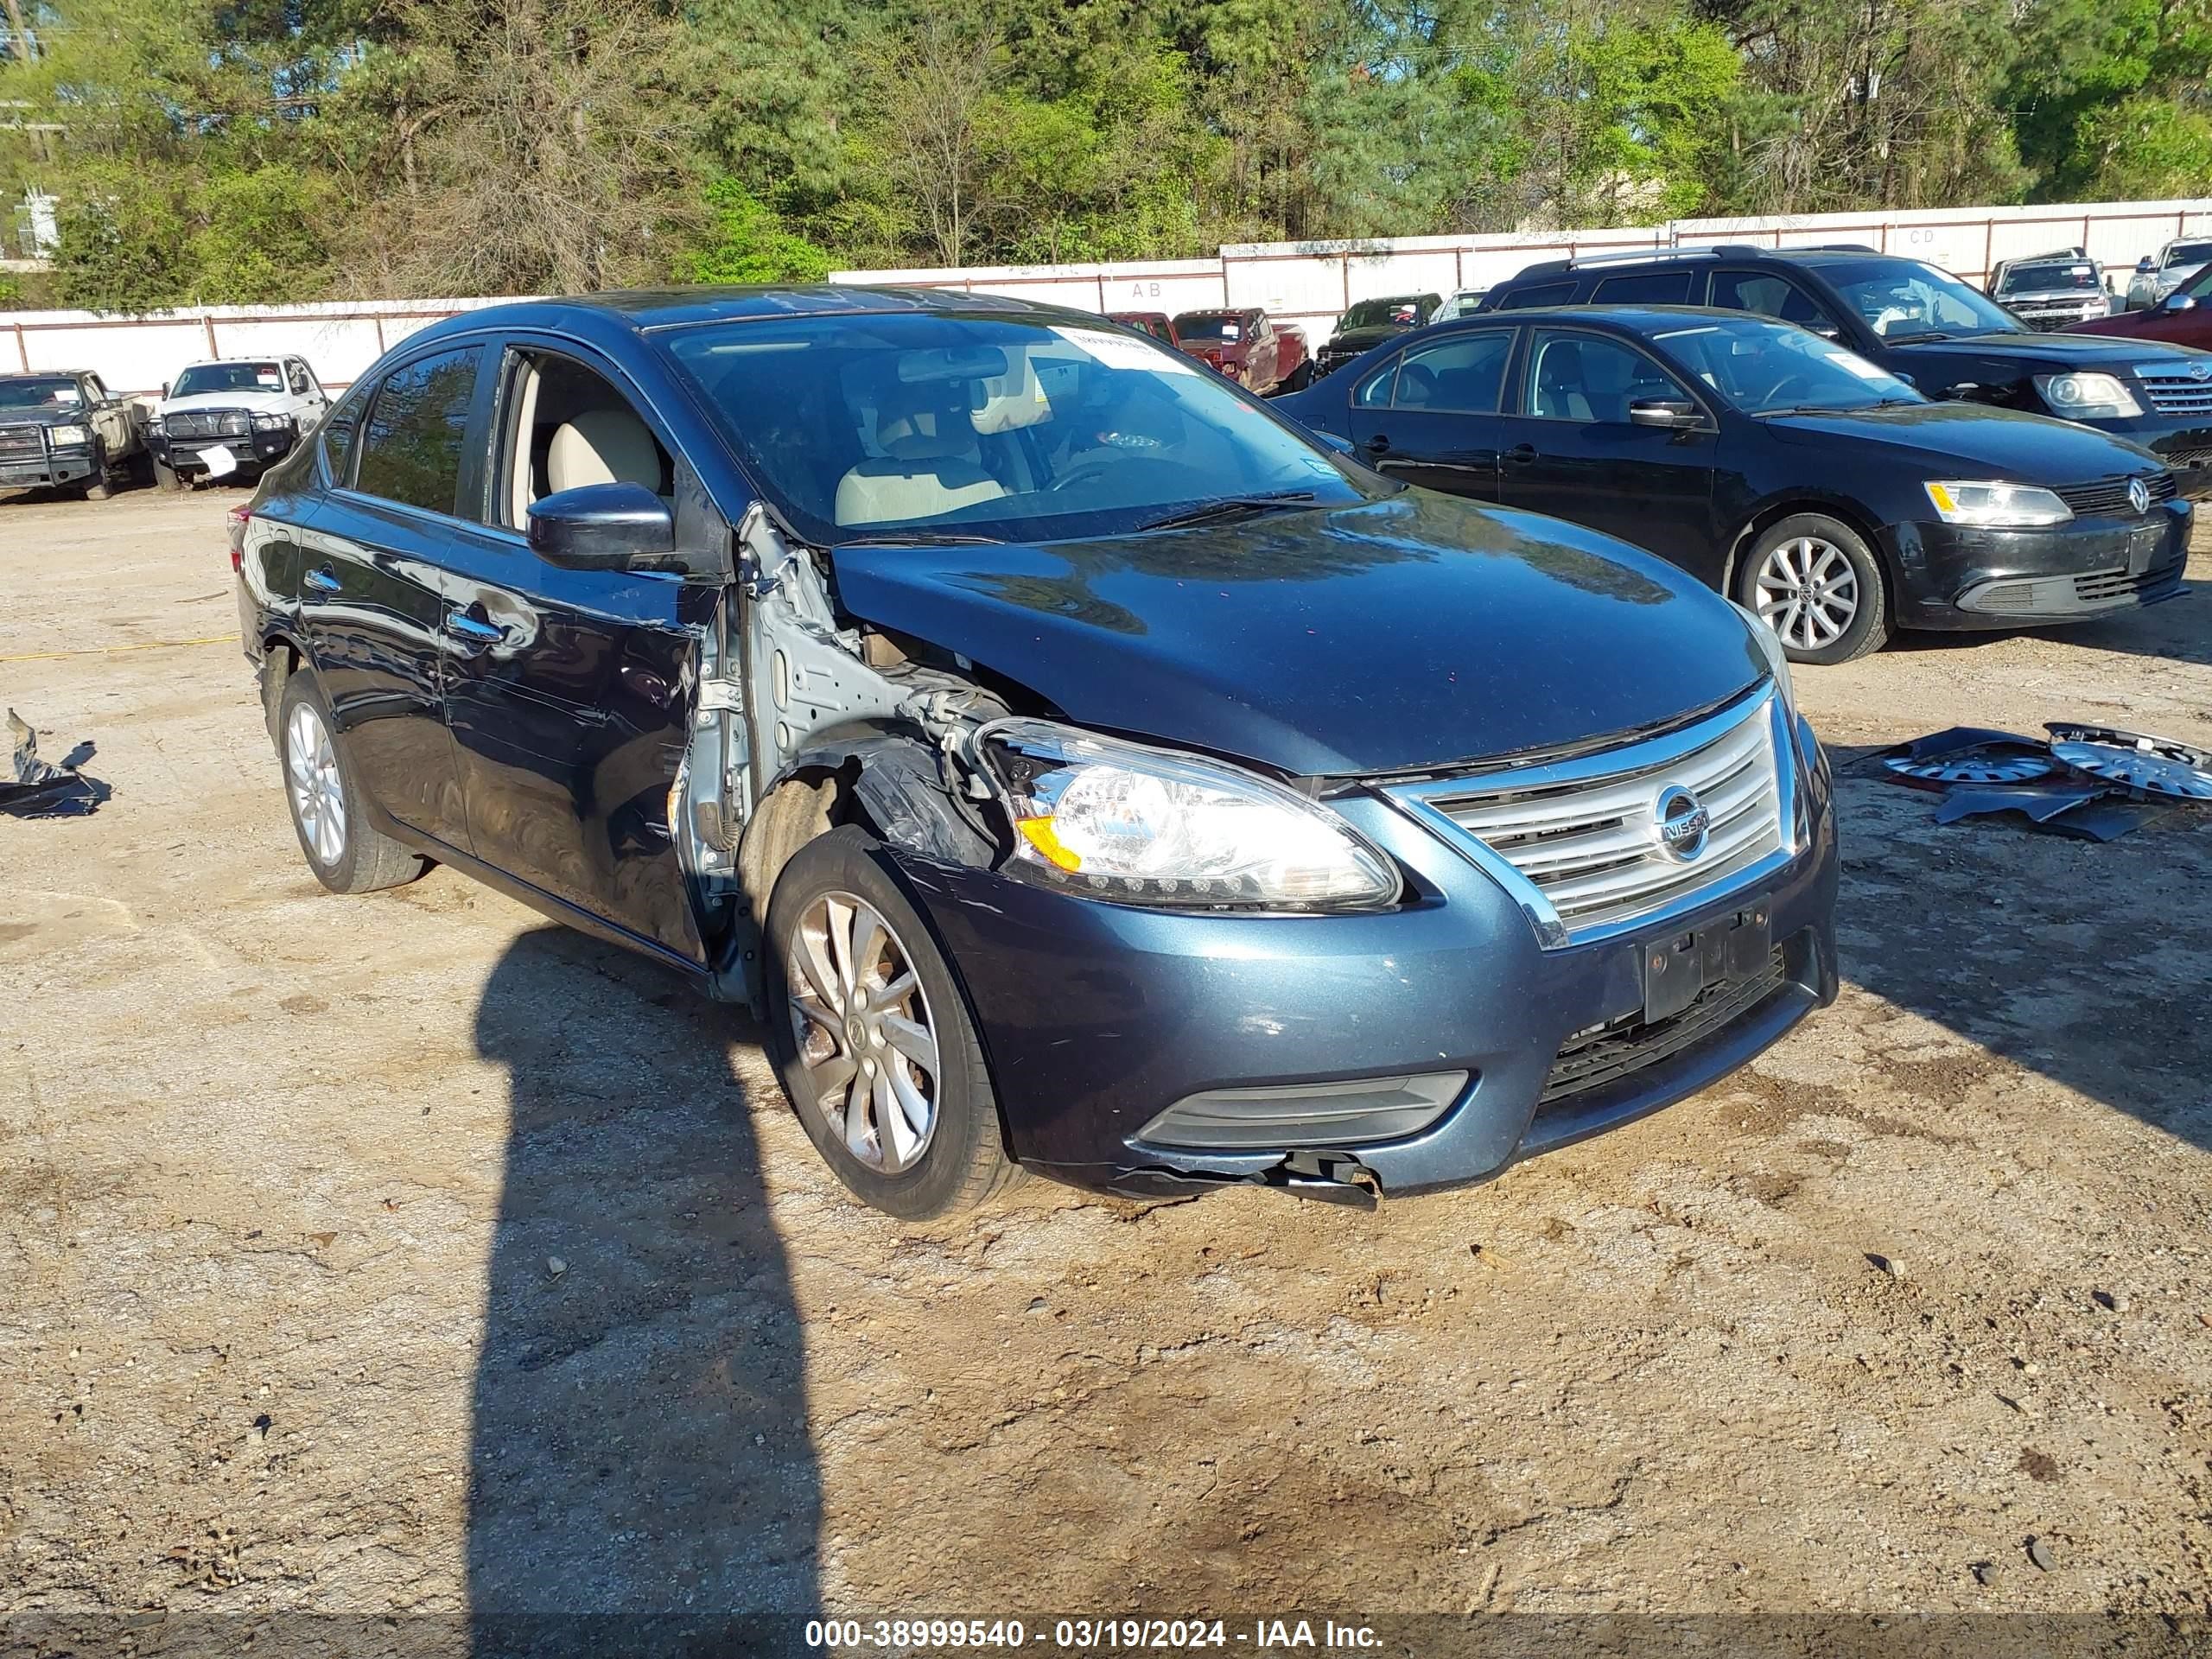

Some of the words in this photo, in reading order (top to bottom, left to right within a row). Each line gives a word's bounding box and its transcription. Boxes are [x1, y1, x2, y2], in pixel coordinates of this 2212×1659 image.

[1132, 283, 1143, 298] A
[1149, 283, 1160, 297] B
[1663, 813, 1708, 838] NISSAN
